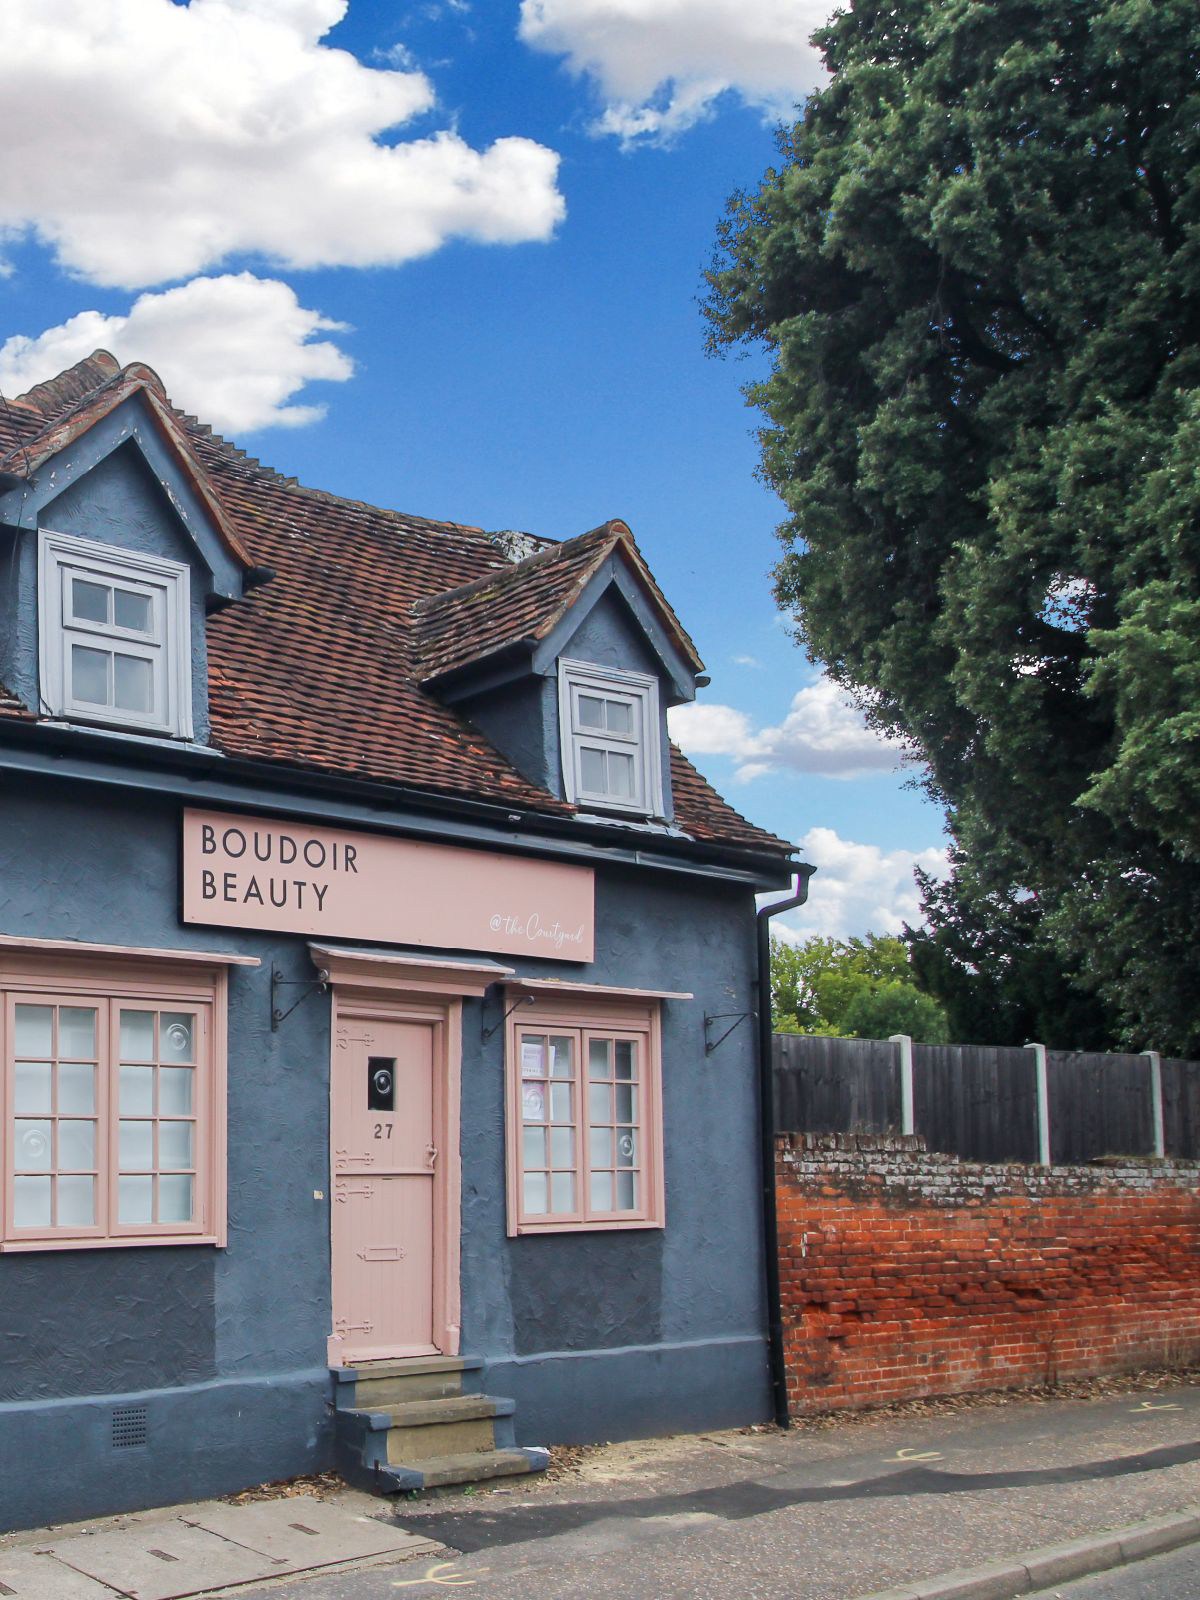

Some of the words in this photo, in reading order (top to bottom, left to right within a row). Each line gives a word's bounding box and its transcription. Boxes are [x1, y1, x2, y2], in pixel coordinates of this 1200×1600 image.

[202, 824, 358, 873] BOUDOIR
[202, 869, 328, 911] BEAUTY
[526, 913, 585, 950] Courtyard
[374, 1123, 393, 1140] 27
